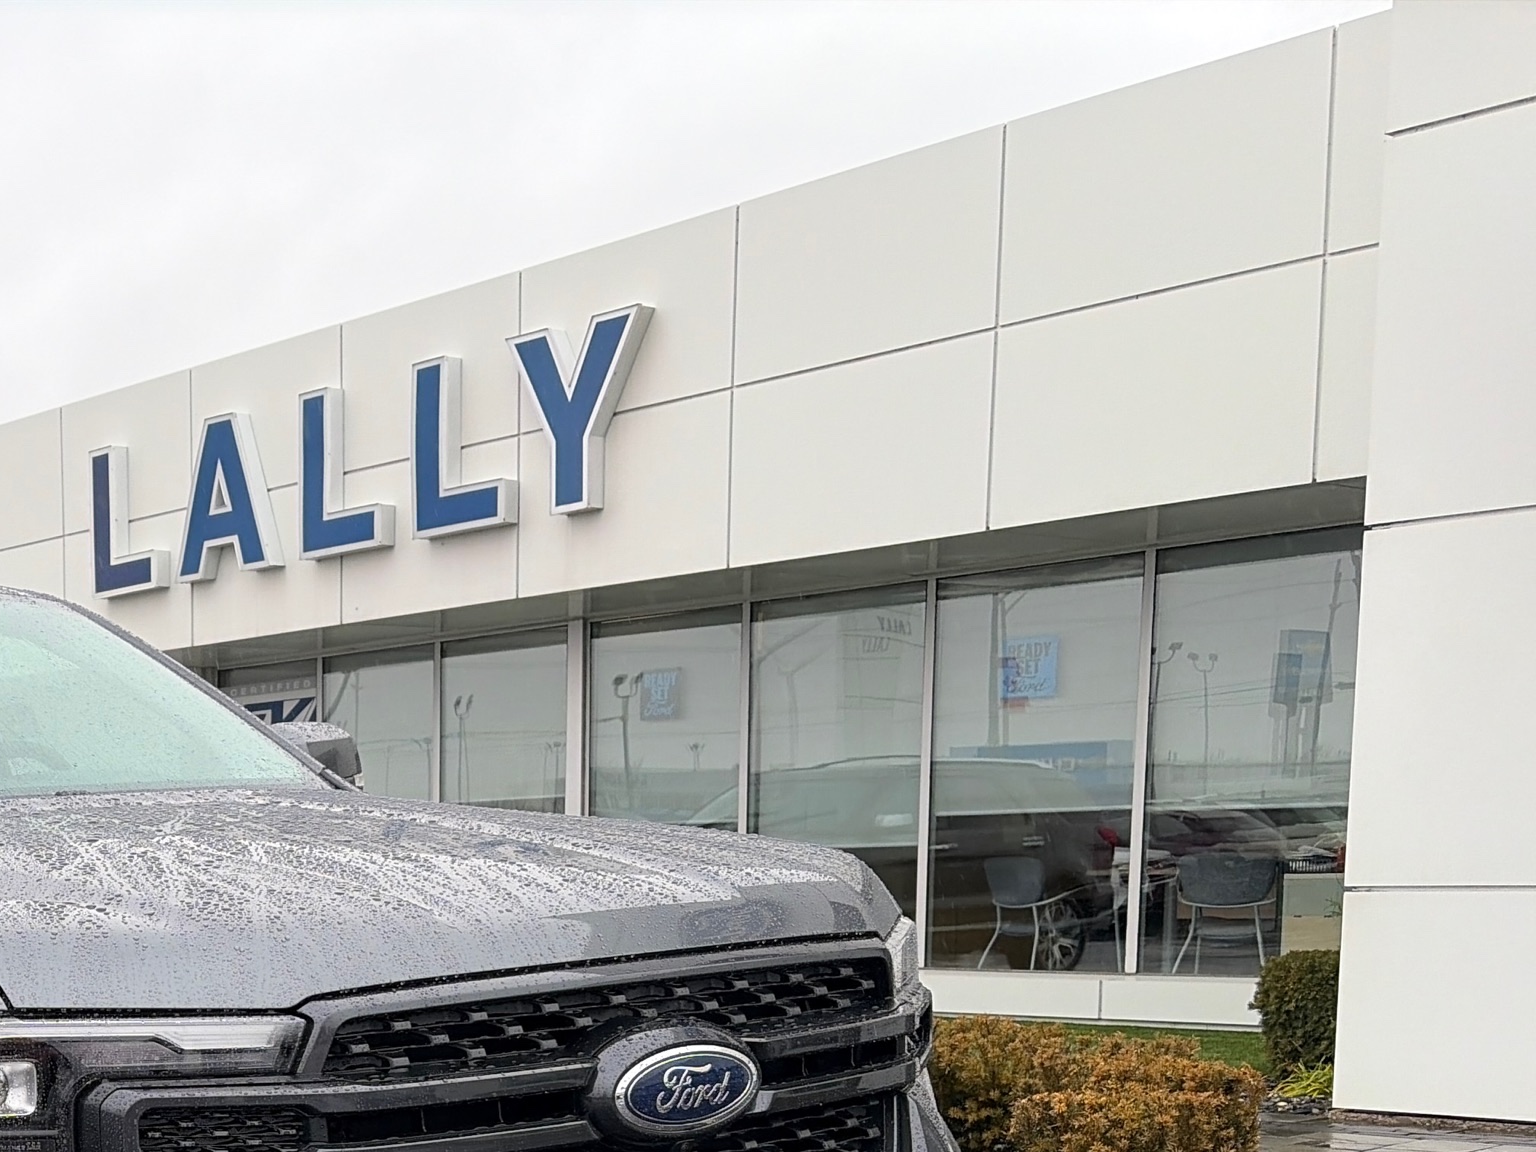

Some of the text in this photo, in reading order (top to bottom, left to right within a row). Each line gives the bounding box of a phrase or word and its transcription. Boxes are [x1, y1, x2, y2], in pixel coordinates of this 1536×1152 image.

[88, 302, 654, 599] LALLY
[1008, 641, 1052, 659] READY
[1017, 658, 1041, 676] SET
[230, 680, 311, 697] CERTIFIED
[656, 1063, 730, 1114] Ford
